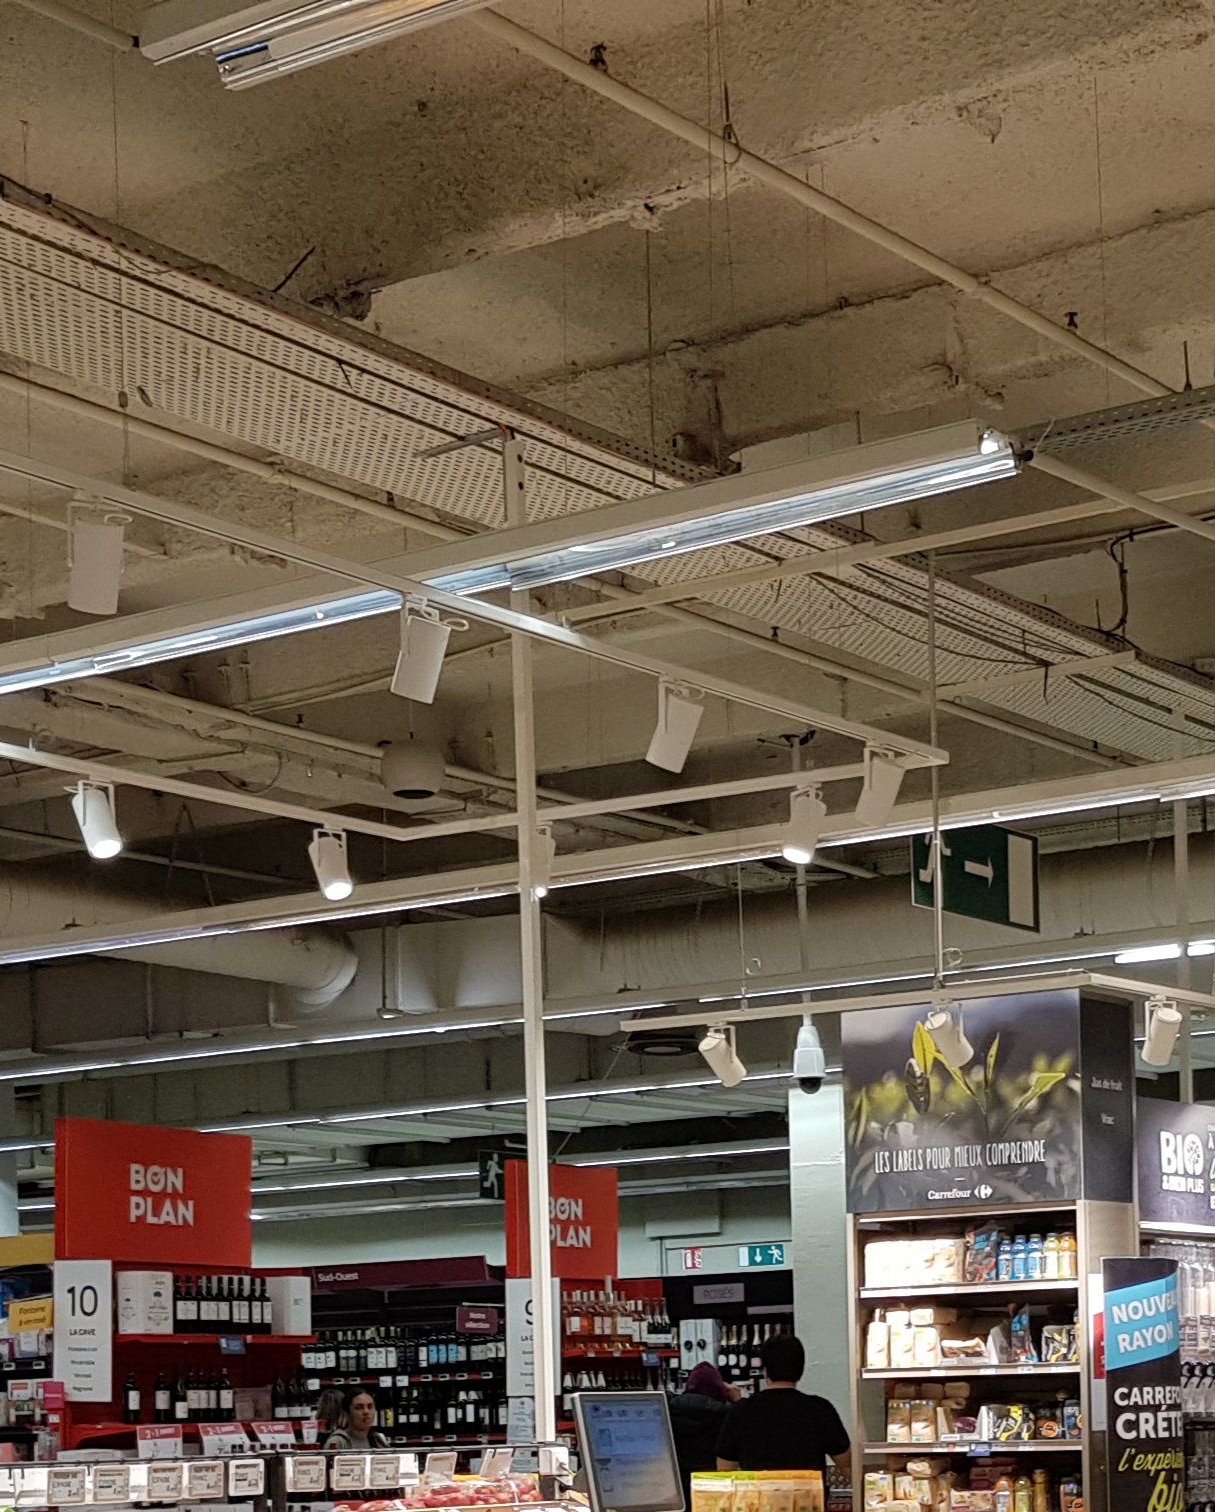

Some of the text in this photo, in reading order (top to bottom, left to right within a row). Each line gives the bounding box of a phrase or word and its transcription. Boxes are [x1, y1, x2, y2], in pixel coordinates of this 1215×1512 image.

[874, 1139, 1046, 1174] LES LABELS POUR MIEUX COMPRENDRE
[1160, 1130, 1204, 1175] BIO
[129, 1163, 183, 1194] BON
[927, 1188, 972, 1200] Carrefour
[1187, 1177, 1204, 1193] PLUS
[129, 1195, 195, 1227] PLAN
[318, 1271, 359, 1283] Sud-Ouest
[66, 1285, 98, 1317] 10
[1117, 1321, 1174, 1354] RAYON
